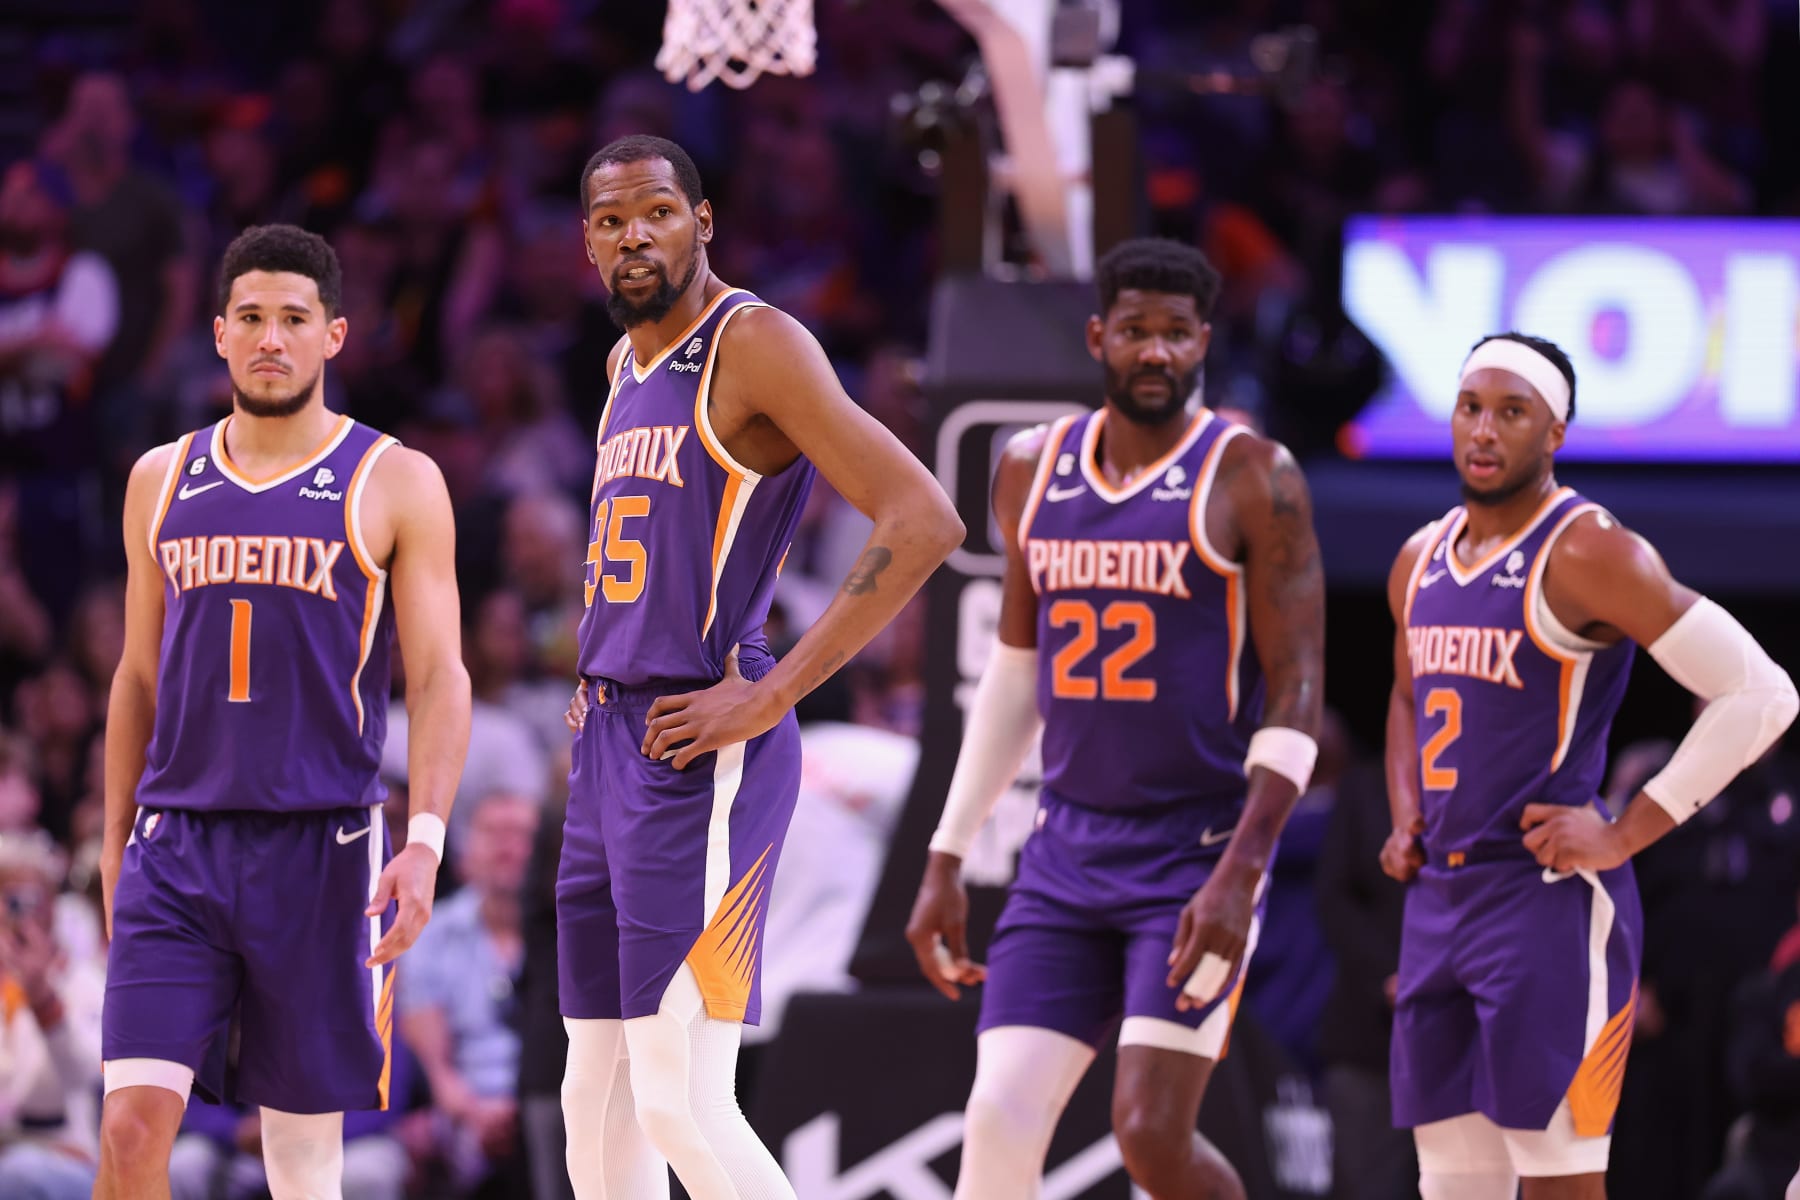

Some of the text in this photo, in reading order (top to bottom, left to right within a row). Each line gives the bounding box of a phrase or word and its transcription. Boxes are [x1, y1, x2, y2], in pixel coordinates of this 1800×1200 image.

[668, 360, 703, 374] PayPal
[188, 455, 207, 476] 6
[298, 487, 342, 502] PayPal
[158, 535, 346, 602] PHOENIX
[1027, 538, 1192, 600] PHOENIX
[227, 598, 253, 703] 1
[1049, 599, 1158, 701] 22
[1420, 686, 1463, 791] 2
